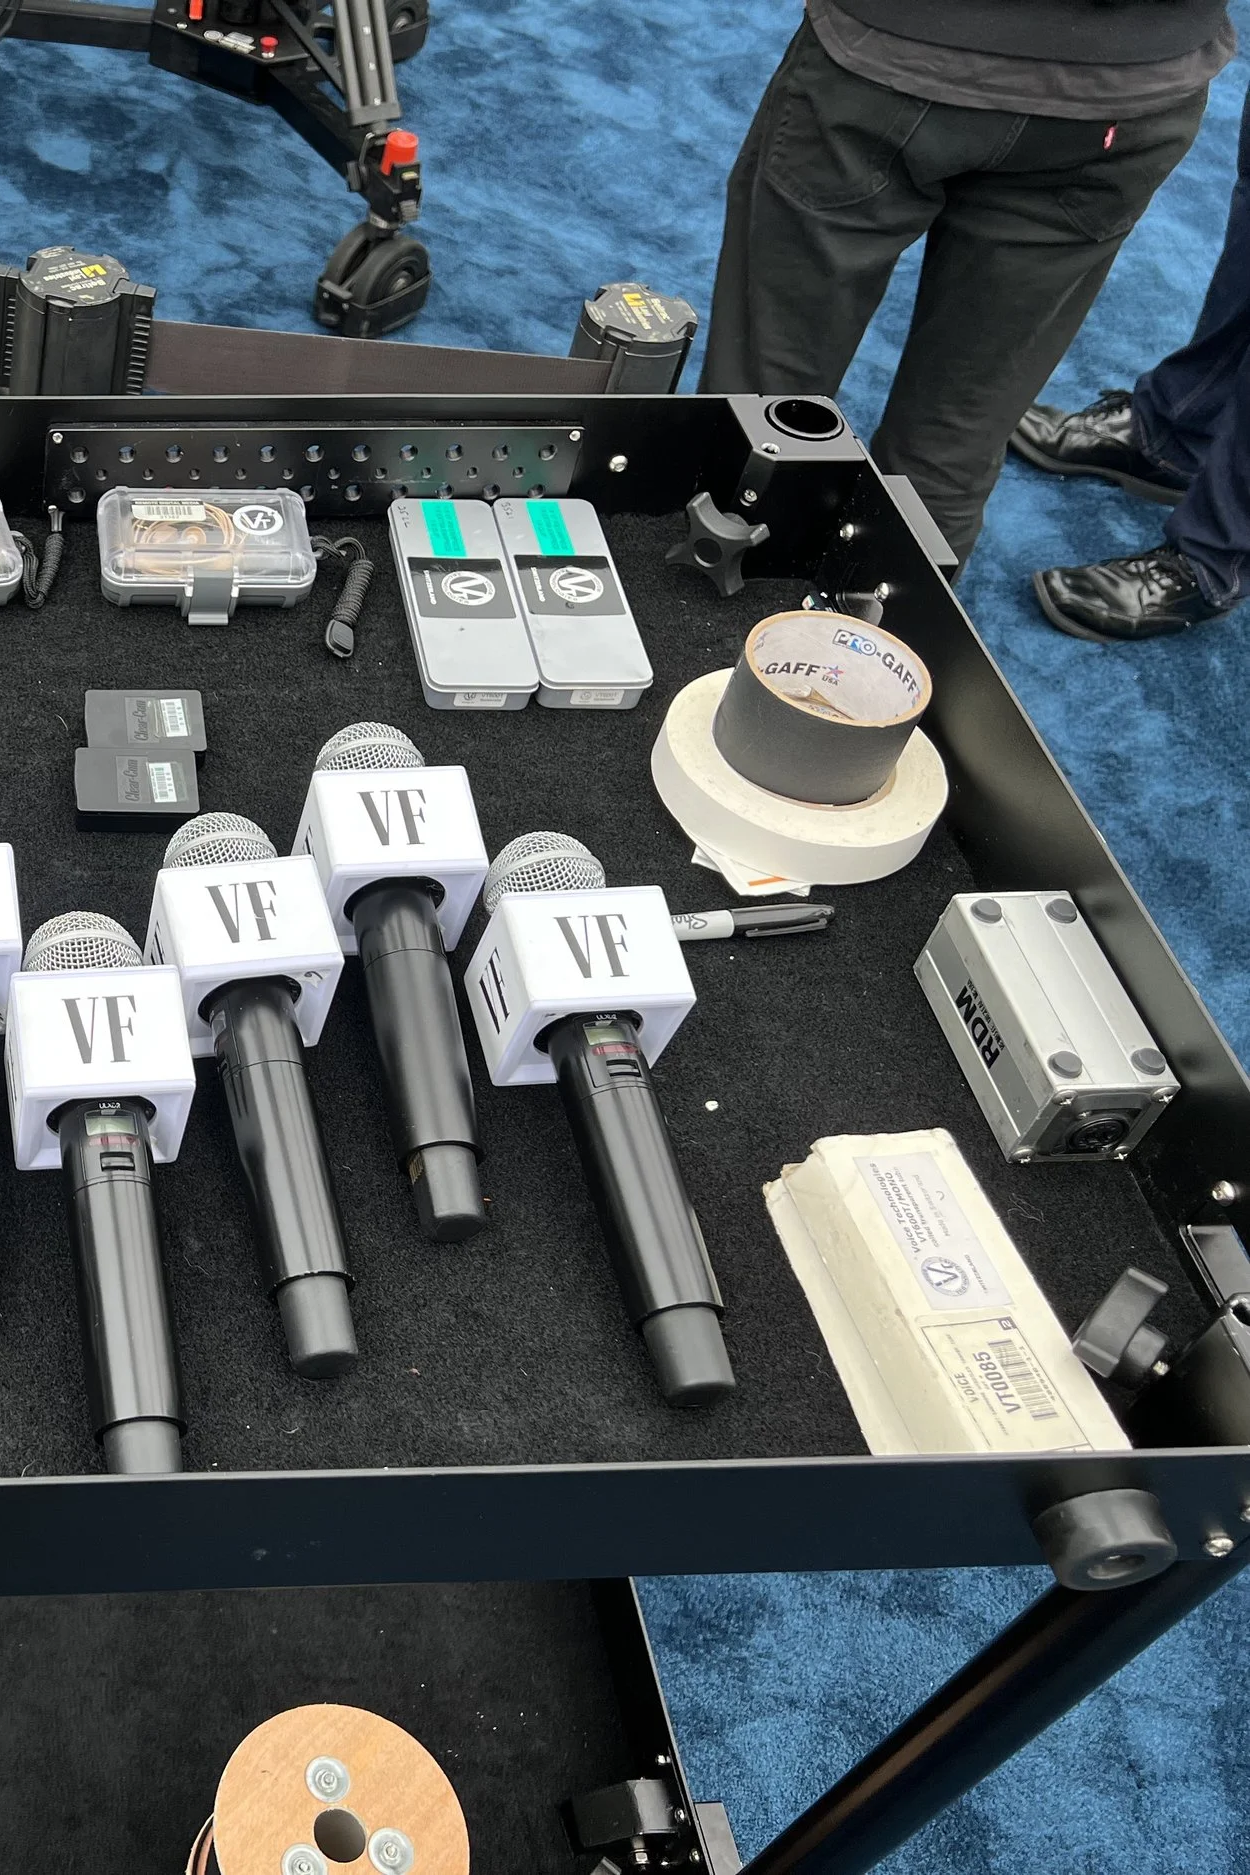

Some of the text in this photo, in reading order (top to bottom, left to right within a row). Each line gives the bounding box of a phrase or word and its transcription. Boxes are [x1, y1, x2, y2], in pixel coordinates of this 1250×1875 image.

[822, 675, 840, 686] USA
[132, 700, 149, 741] Clear-Com
[123, 760, 140, 802] Clear-Com
[357, 789, 426, 845] VF
[205, 880, 277, 943] VF
[553, 913, 630, 978] VF
[479, 947, 510, 1034] VF
[61, 995, 136, 1064] VF
[956, 985, 1000, 1069] RDM
[870, 1163, 921, 1253] Voice Technologies
[884, 1172, 927, 1243] VT600T/MONO
[901, 1182, 927, 1224] transparent
[954, 1373, 979, 1403] VOICE
[972, 1352, 1021, 1413] VT0085
